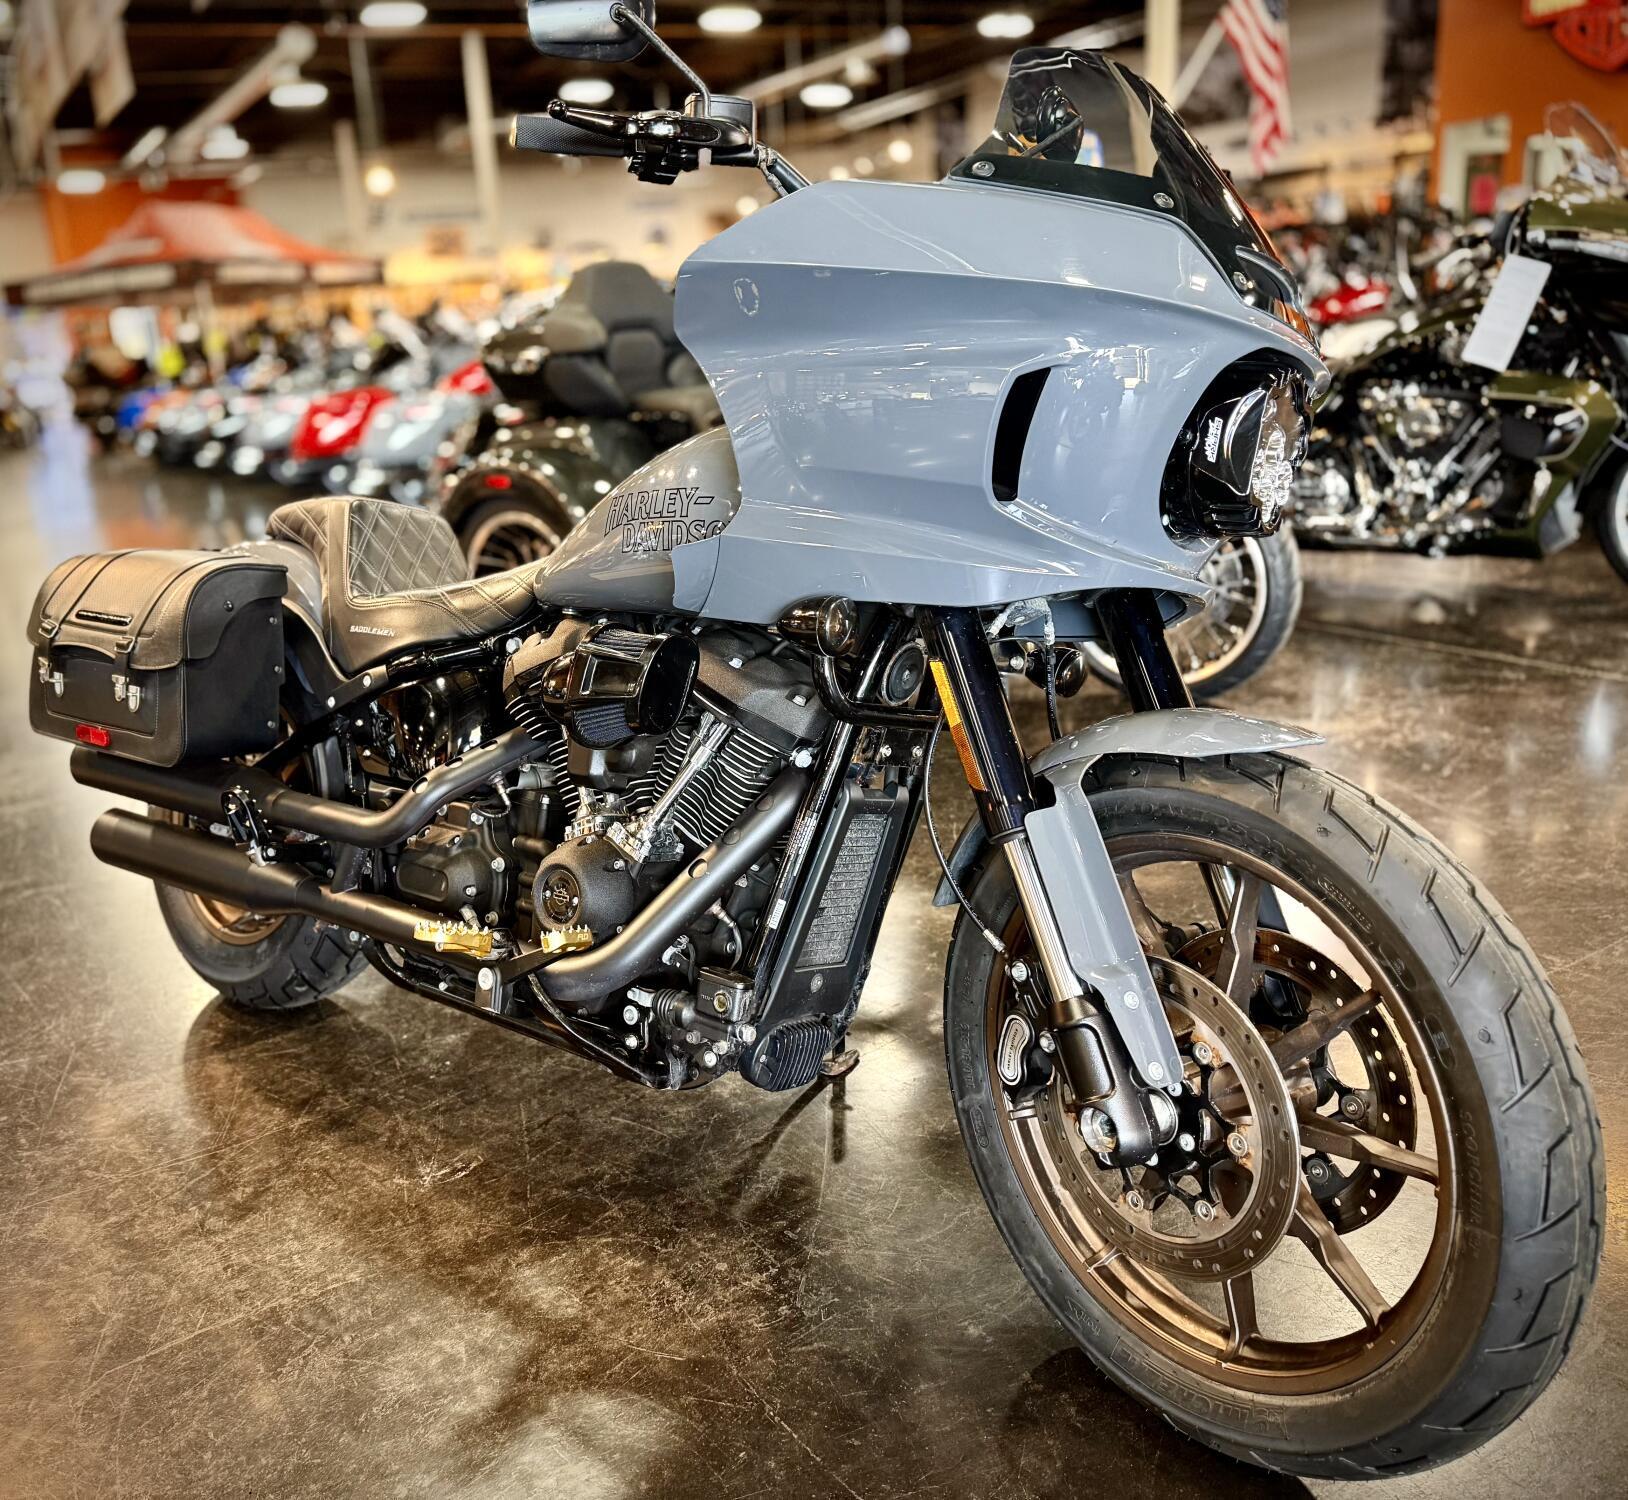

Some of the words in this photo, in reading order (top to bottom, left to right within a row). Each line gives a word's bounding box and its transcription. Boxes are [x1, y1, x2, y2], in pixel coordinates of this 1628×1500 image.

[604, 487, 715, 537] HARLEY-
[622, 520, 731, 553] DAVIDSO
[350, 625, 396, 637] SADDLEMEN
